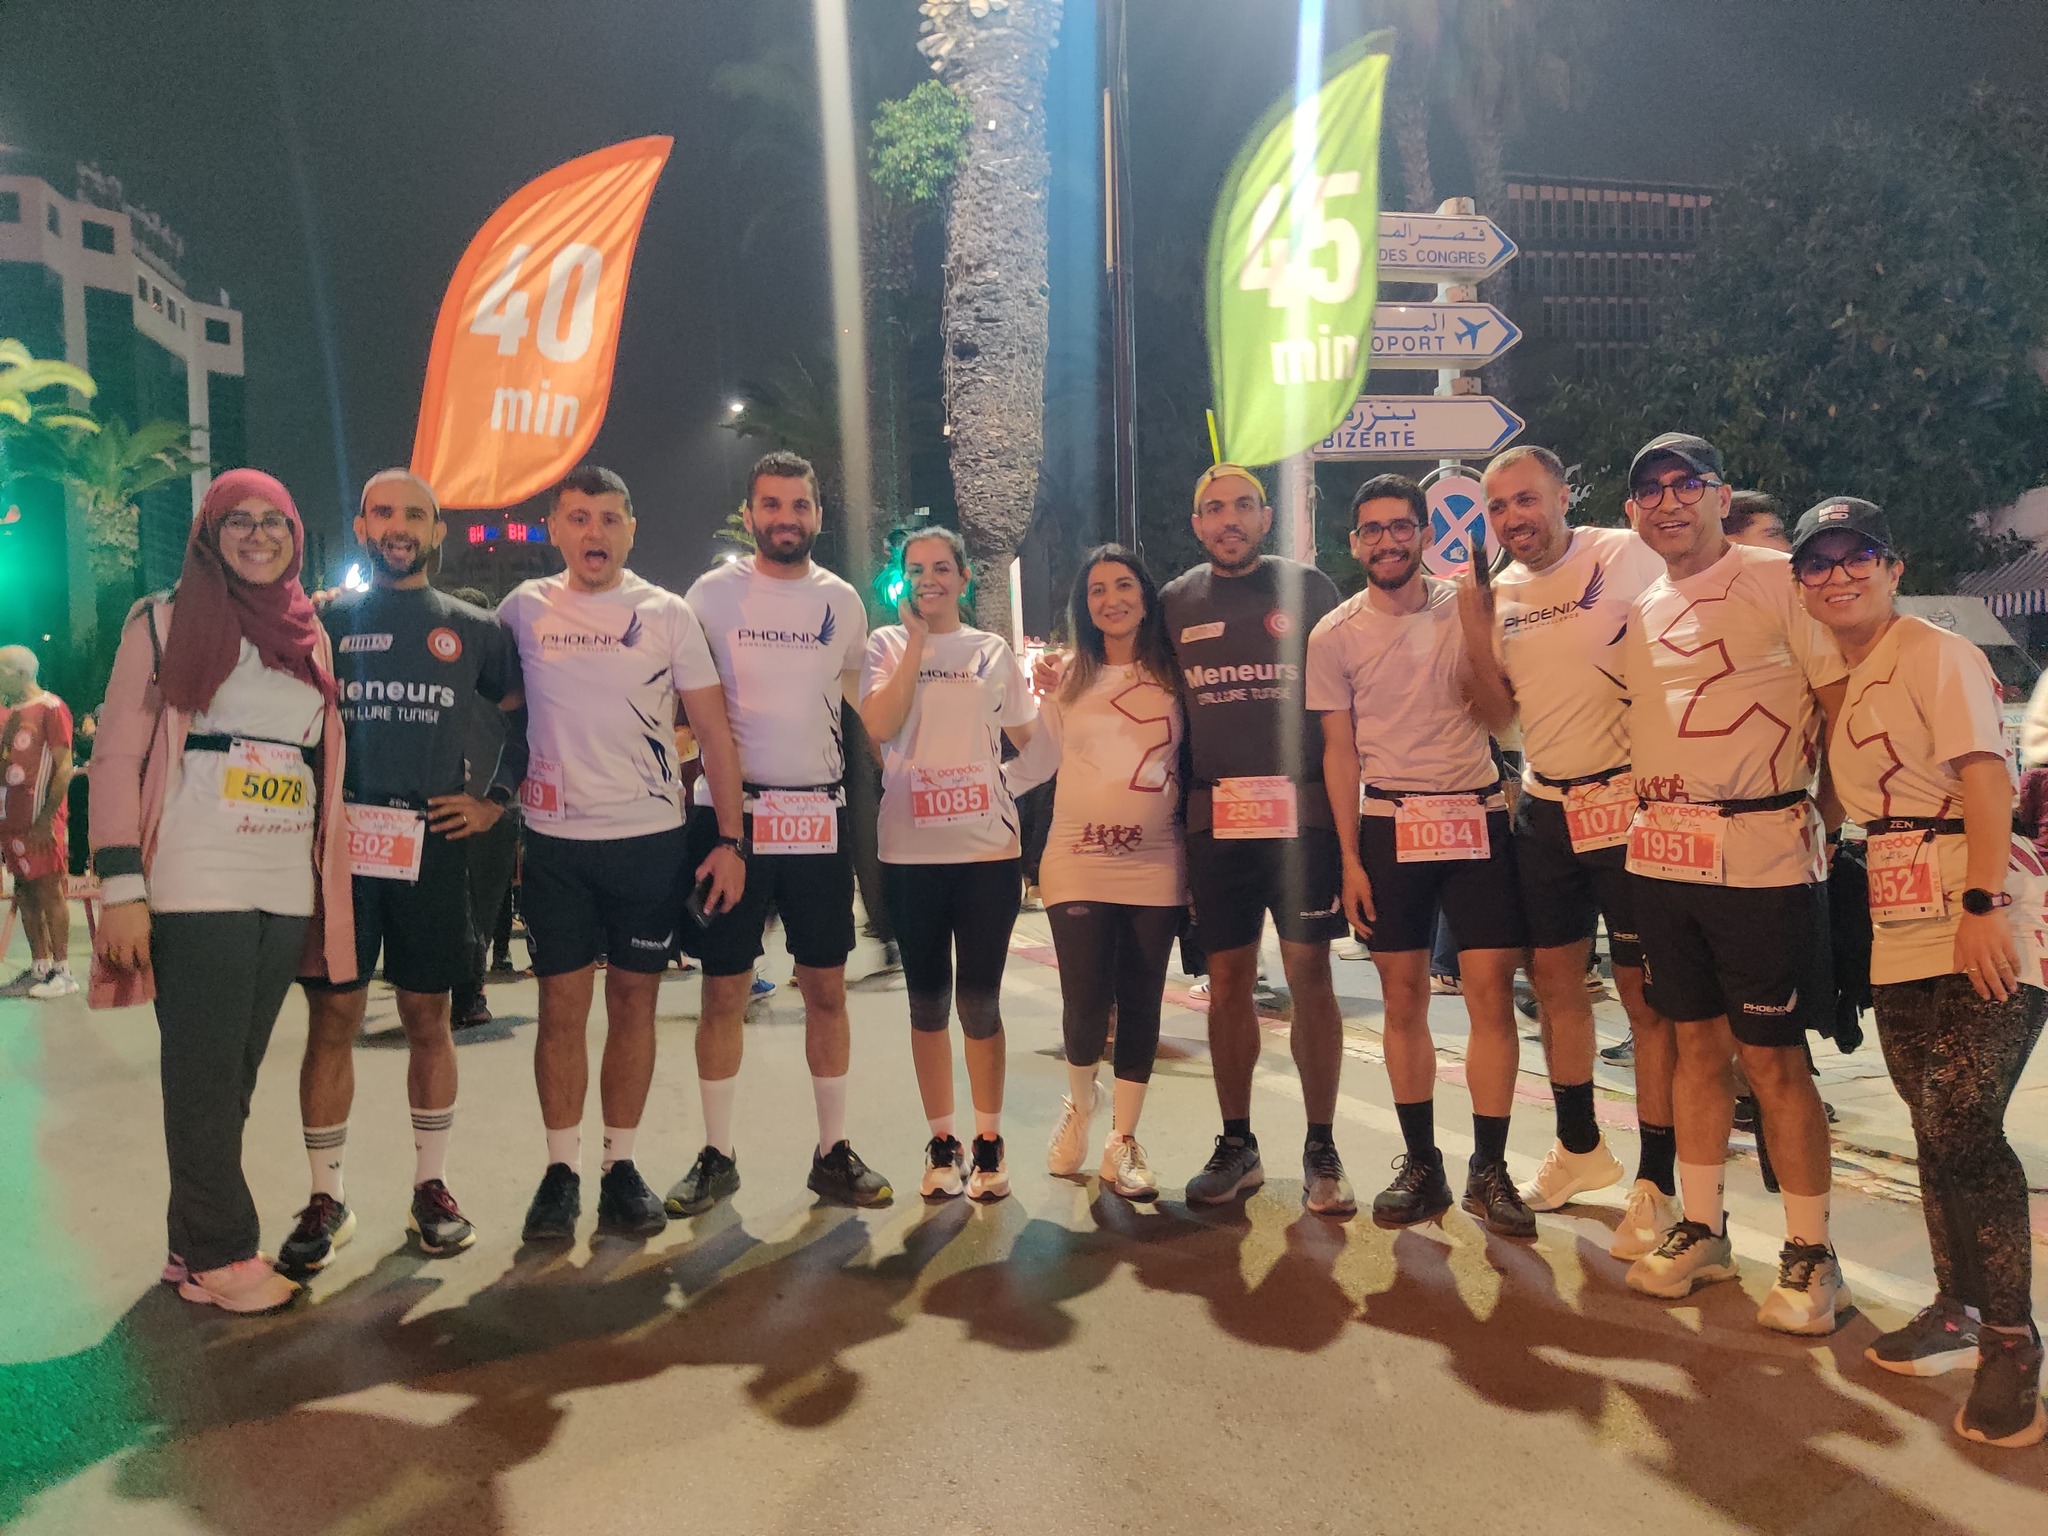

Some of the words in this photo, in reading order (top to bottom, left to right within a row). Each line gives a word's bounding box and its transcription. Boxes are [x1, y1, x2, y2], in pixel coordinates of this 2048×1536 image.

[1240, 170, 1361, 306] 45
[1379, 248, 1408, 261] DES
[1416, 249, 1487, 264] CONGRES
[469, 243, 604, 363] 40
[1270, 324, 1358, 386] min
[1371, 335, 1445, 352] OPORT
[490, 379, 581, 437] min
[1322, 430, 1416, 448] BIZERTE
[508, 522, 527, 541] BH
[1504, 600, 1580, 628] PHOENIX
[738, 629, 819, 644] PHOENIX
[919, 669, 978, 679] HOENIX
[1184, 663, 1299, 689] Meneurs
[937, 762, 984, 778] ooredoo
[242, 774, 302, 803] 5078
[522, 780, 544, 807] 19
[783, 792, 829, 804] ooredoo
[924, 787, 982, 815] 1085
[1226, 801, 1275, 822] 2504
[1425, 797, 1478, 808] ooredoo
[1660, 805, 1719, 821] ooredoo
[1889, 820, 1915, 829] ZEN
[769, 816, 825, 841] 1087
[1409, 821, 1473, 848] 1084
[1641, 831, 1695, 864] 1951
